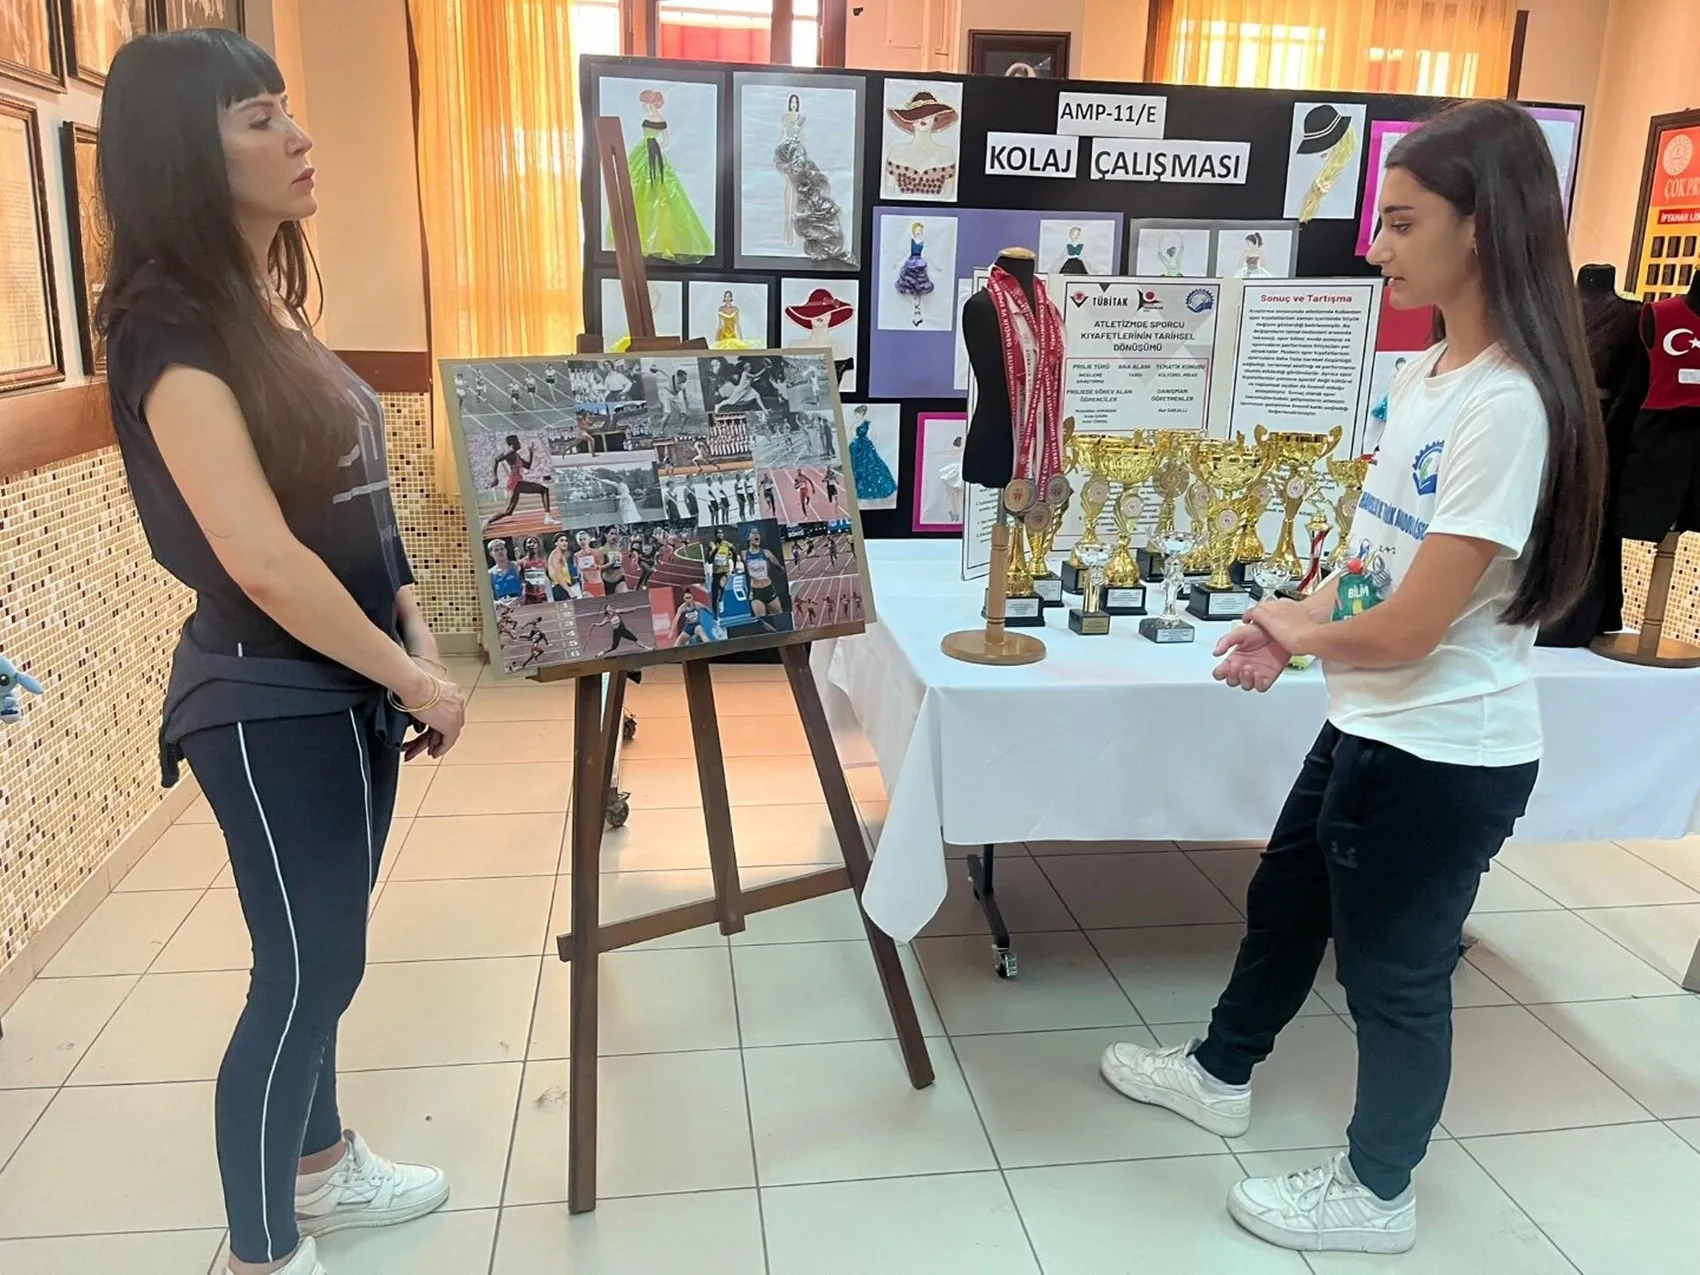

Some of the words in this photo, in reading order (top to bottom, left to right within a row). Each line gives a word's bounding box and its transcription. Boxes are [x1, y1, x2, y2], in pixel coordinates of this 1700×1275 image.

[1060, 102, 1156, 126] AMP-11/E
[989, 145, 1072, 173] KOLAJ
[1095, 150, 1240, 181] ÇALIŞMASI
[1092, 296, 1128, 306] TÜBİTAK
[1260, 294, 1290, 303] Sonuç
[1307, 294, 1352, 303] Tartışma
[1094, 320, 1148, 328] ATLETİZMDE
[1080, 331, 1152, 339] KIYAFETLERİNİN
[1154, 332, 1195, 340] TARİHSEL
[1114, 342, 1162, 352] DÖNÜŞÜMÜ
[1348, 584, 1369, 598] BİLİM
